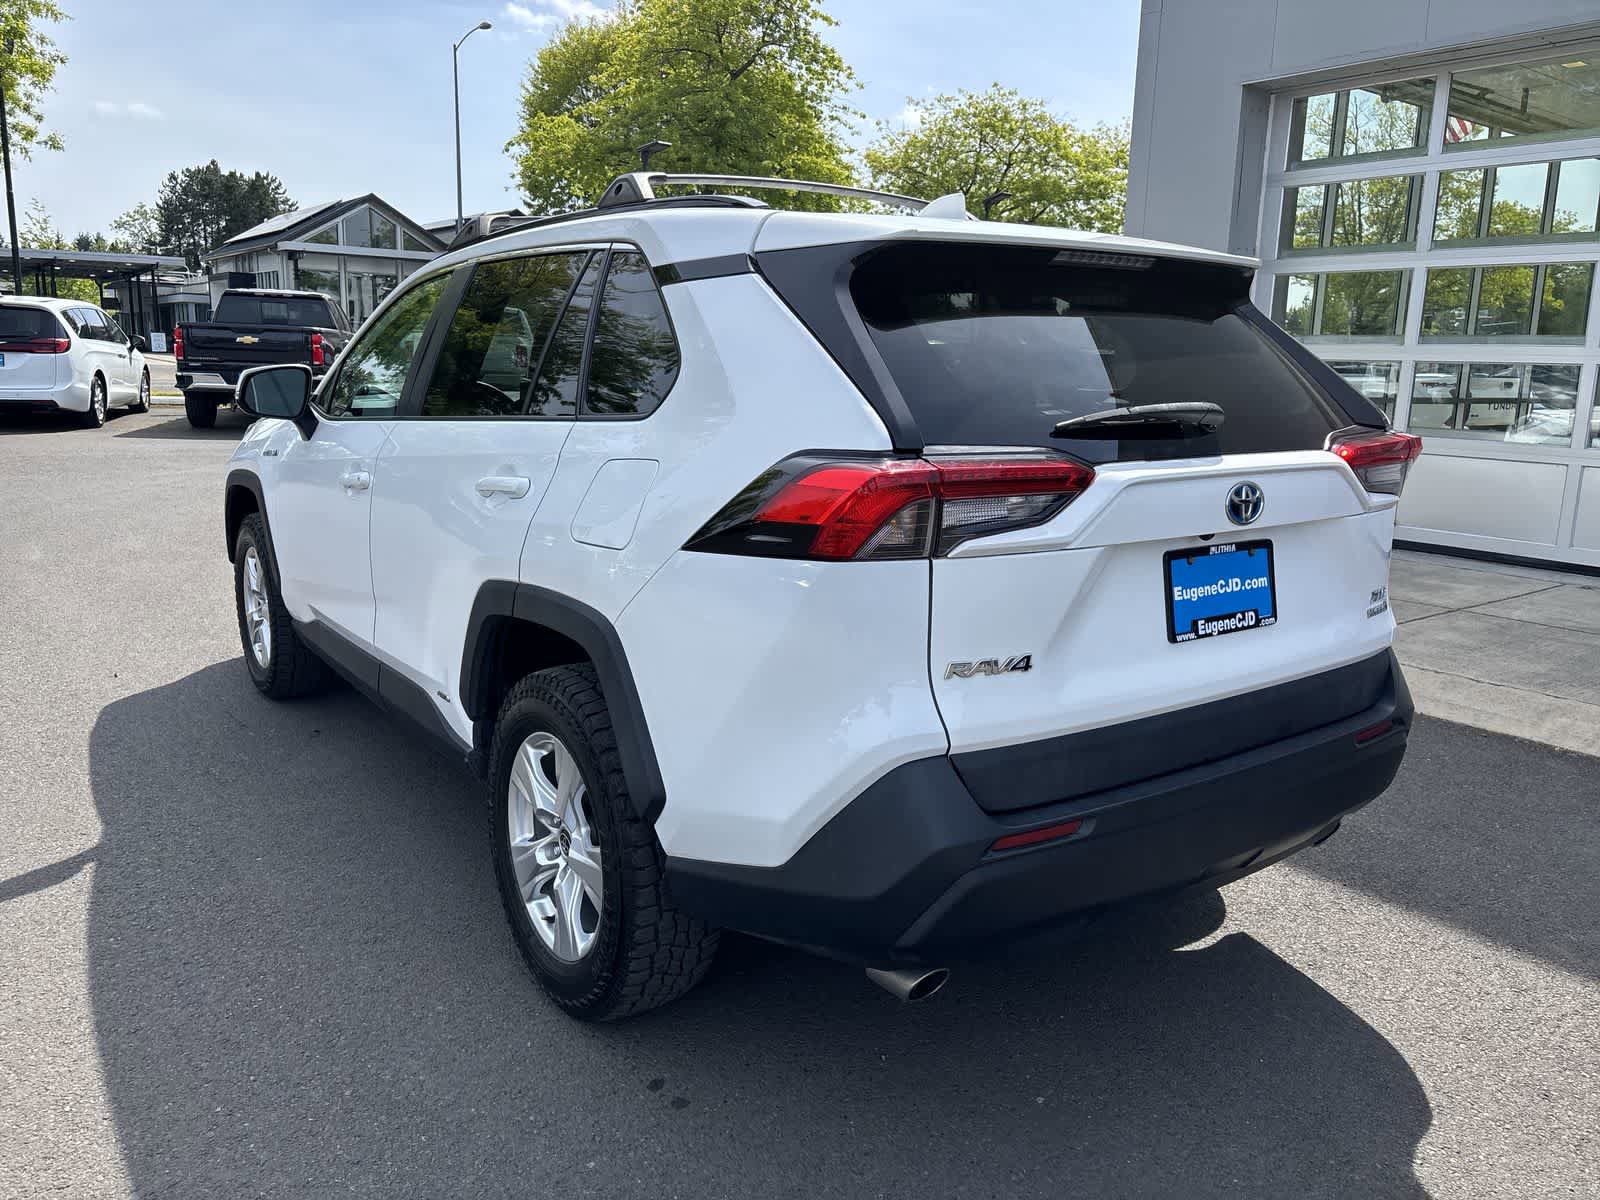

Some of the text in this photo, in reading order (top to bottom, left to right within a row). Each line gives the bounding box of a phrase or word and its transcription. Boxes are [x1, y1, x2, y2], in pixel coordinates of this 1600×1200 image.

[1174, 577, 1268, 601] EugeneCJD.com
[1176, 611, 1276, 641] www. EugeneCJD .com
[944, 654, 1032, 680] RAV4
